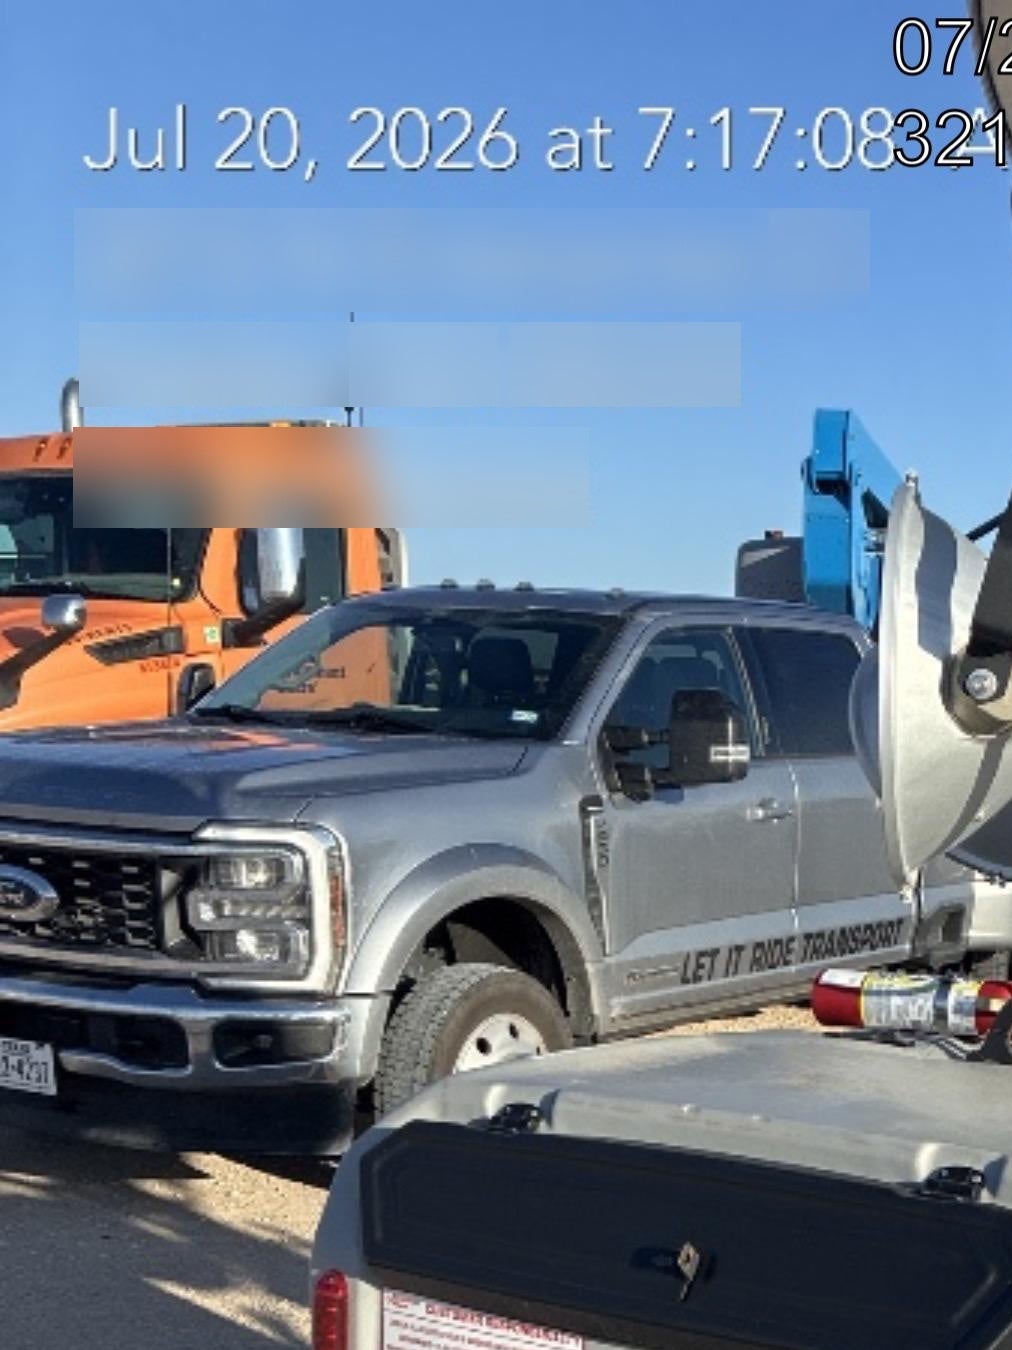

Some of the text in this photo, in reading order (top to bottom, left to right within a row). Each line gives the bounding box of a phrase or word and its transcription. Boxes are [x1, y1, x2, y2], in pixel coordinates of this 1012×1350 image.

[680, 948, 721, 984] LET
[725, 944, 745, 978] IT
[750, 935, 796, 972] RIDE
[801, 917, 905, 963] TRANSPORT
